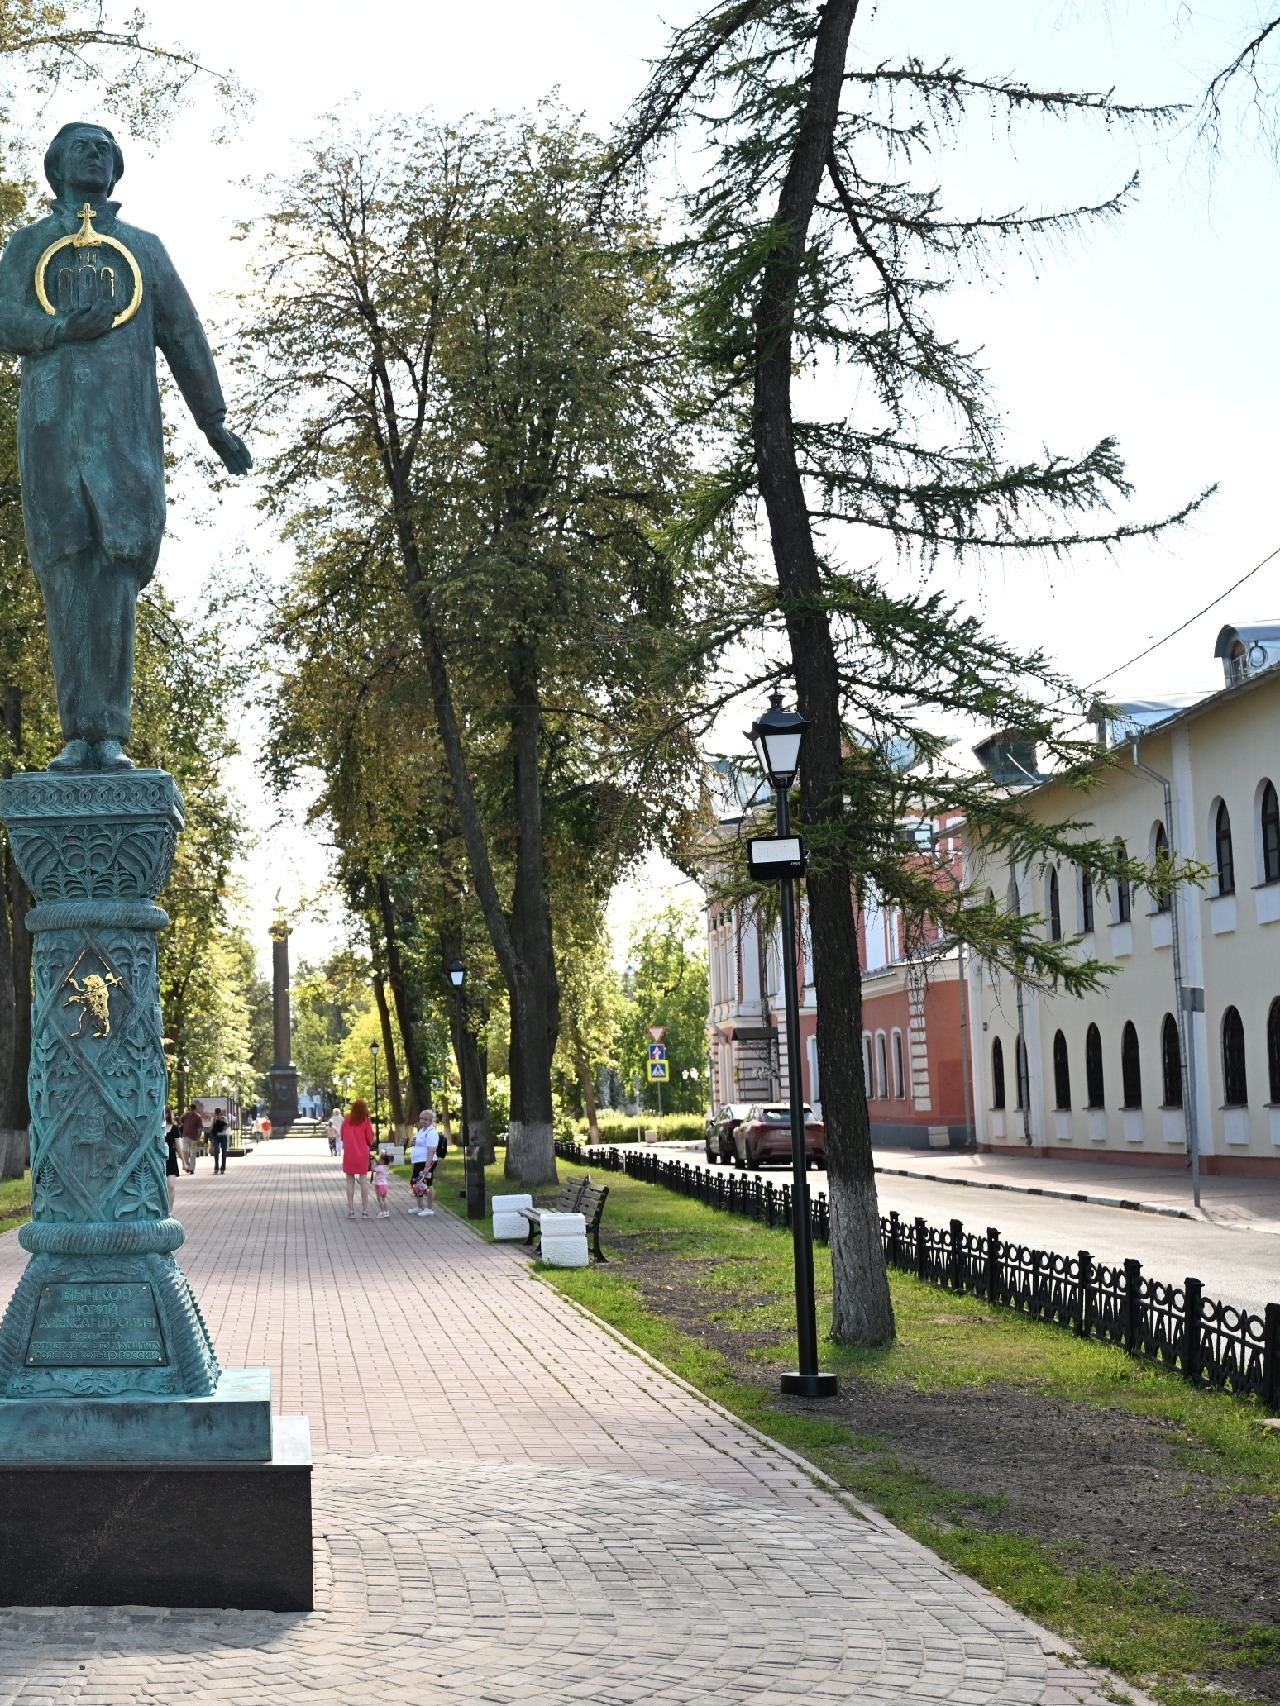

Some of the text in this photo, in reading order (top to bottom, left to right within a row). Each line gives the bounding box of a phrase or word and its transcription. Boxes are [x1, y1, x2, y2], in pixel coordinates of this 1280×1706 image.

[62, 1287, 131, 1302] БЫЧКОВ
[76, 1303, 117, 1316] ЮРИЙ
[39, 1317, 156, 1329] АЛЕКСАНДРОВИЧ
[70, 1332, 122, 1341] СОЗДАТЕЛЬ
[32, 1341, 160, 1350] ТУРИСТИЧЕСКОГО МАРШРУТА
[79, 1350, 117, 1360] КОЛЬЦО
